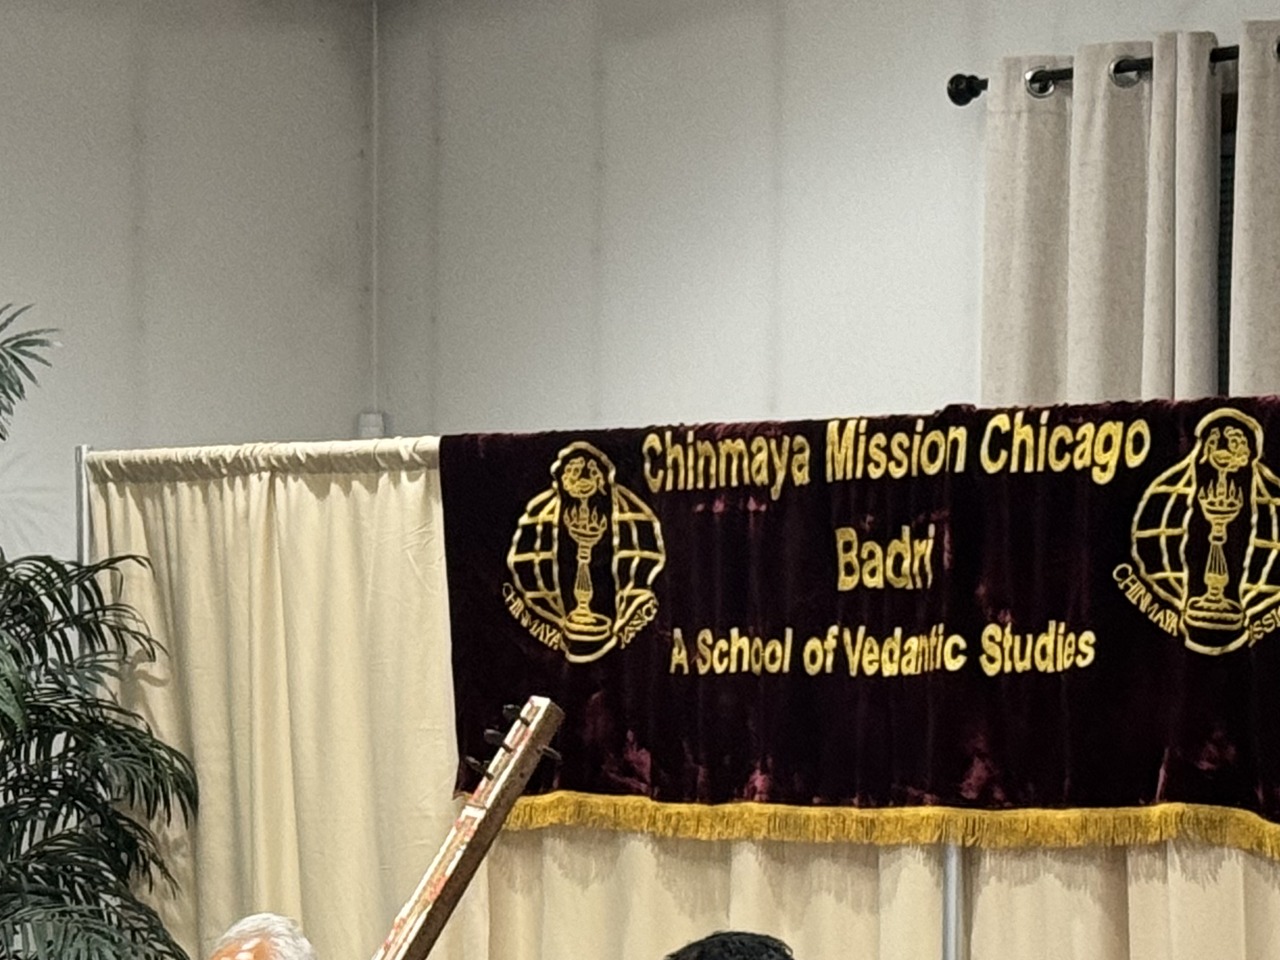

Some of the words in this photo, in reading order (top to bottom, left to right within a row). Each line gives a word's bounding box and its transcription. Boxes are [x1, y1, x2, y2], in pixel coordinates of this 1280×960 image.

[642, 430, 811, 501] Chinmaya
[825, 418, 968, 484] Mission
[980, 410, 1151, 485] Chicago
[834, 523, 936, 592] Badri
[669, 627, 690, 675] A
[695, 626, 793, 676] School
[803, 624, 840, 676] of
[842, 622, 968, 678] Vedantic
[979, 619, 1097, 677] Studies
